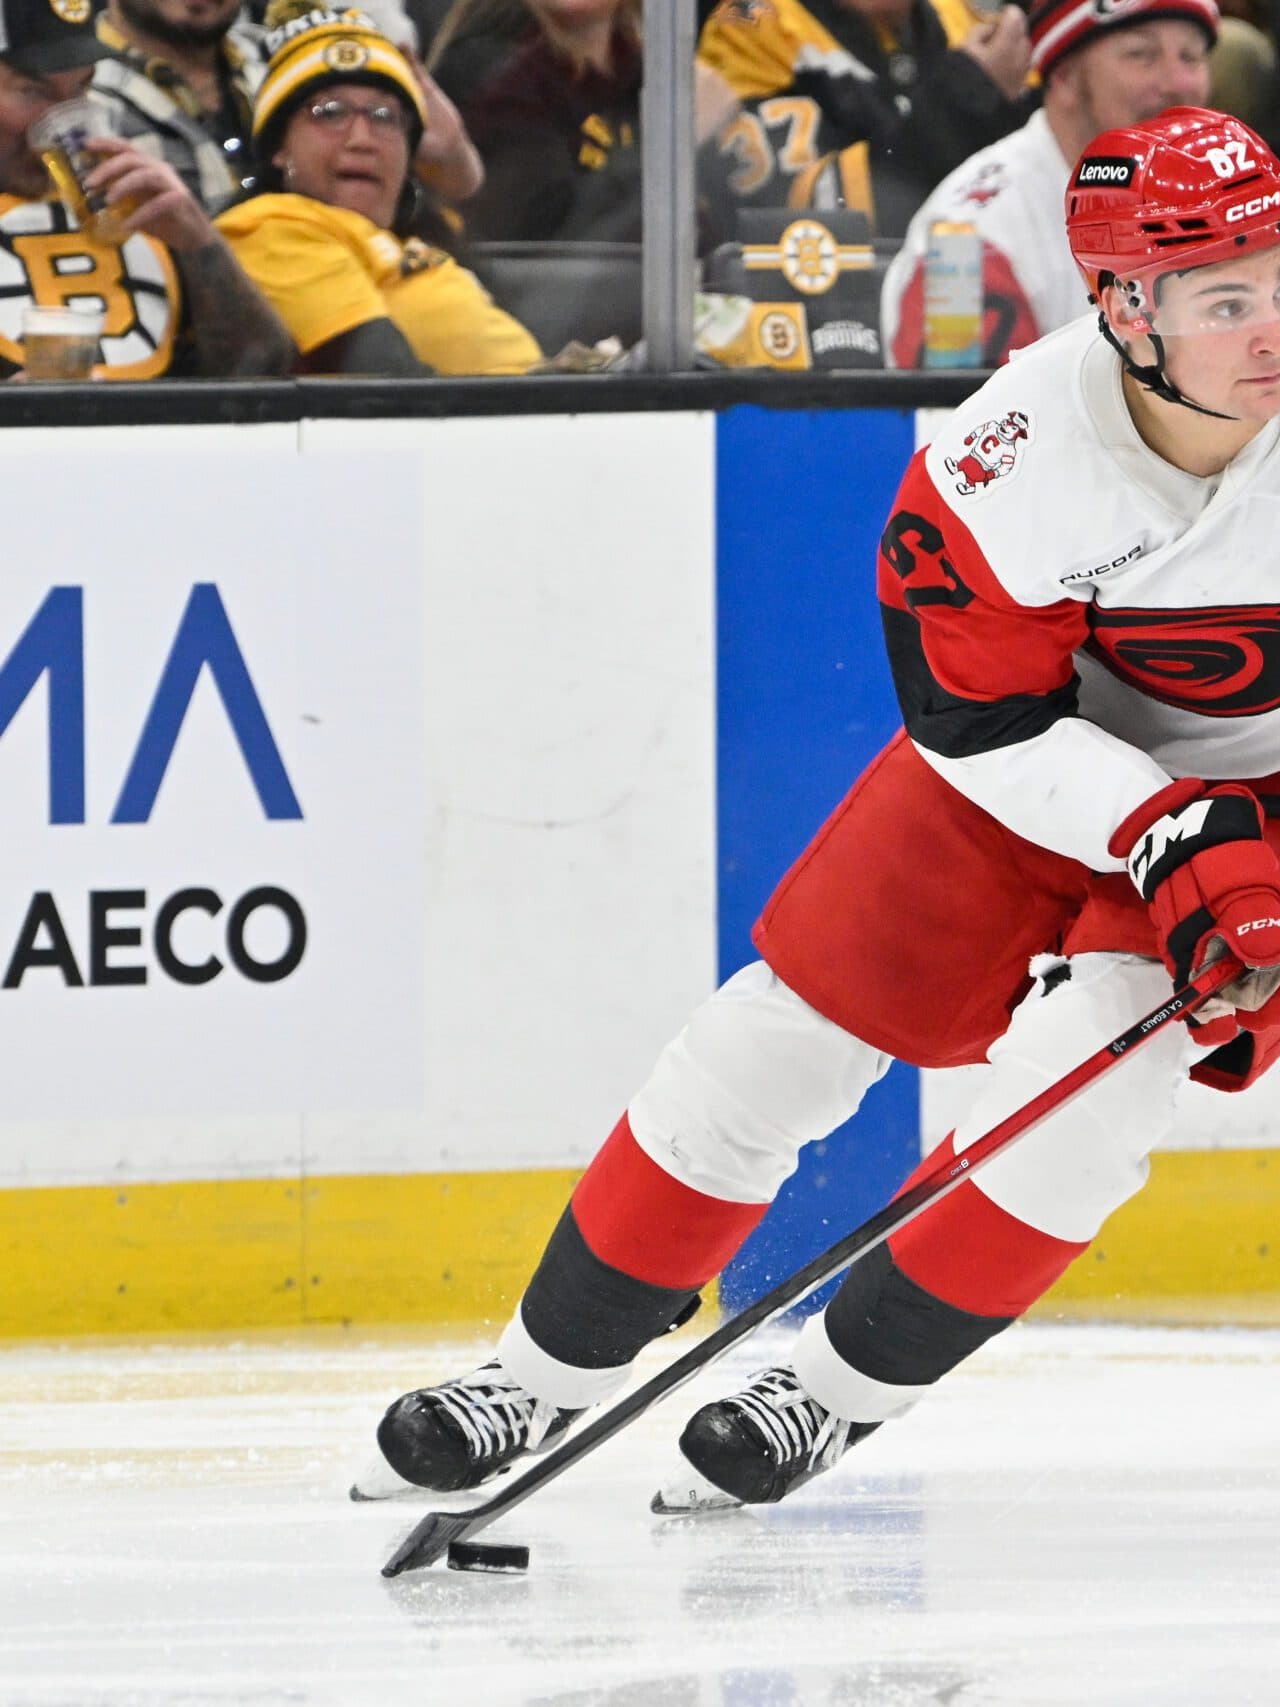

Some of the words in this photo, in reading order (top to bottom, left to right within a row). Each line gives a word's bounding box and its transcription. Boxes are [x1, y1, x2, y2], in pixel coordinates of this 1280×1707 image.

[719, 96, 821, 193] 37
[1206, 141, 1255, 178] 62
[1079, 163, 1129, 181] Lenovo
[1226, 192, 1280, 222] CCM
[12, 232, 136, 337] B
[980, 433, 1001, 455] C
[881, 509, 976, 610] 62
[0, 885, 308, 990] AECO
[1141, 1009, 1170, 1032] LEGAULT
